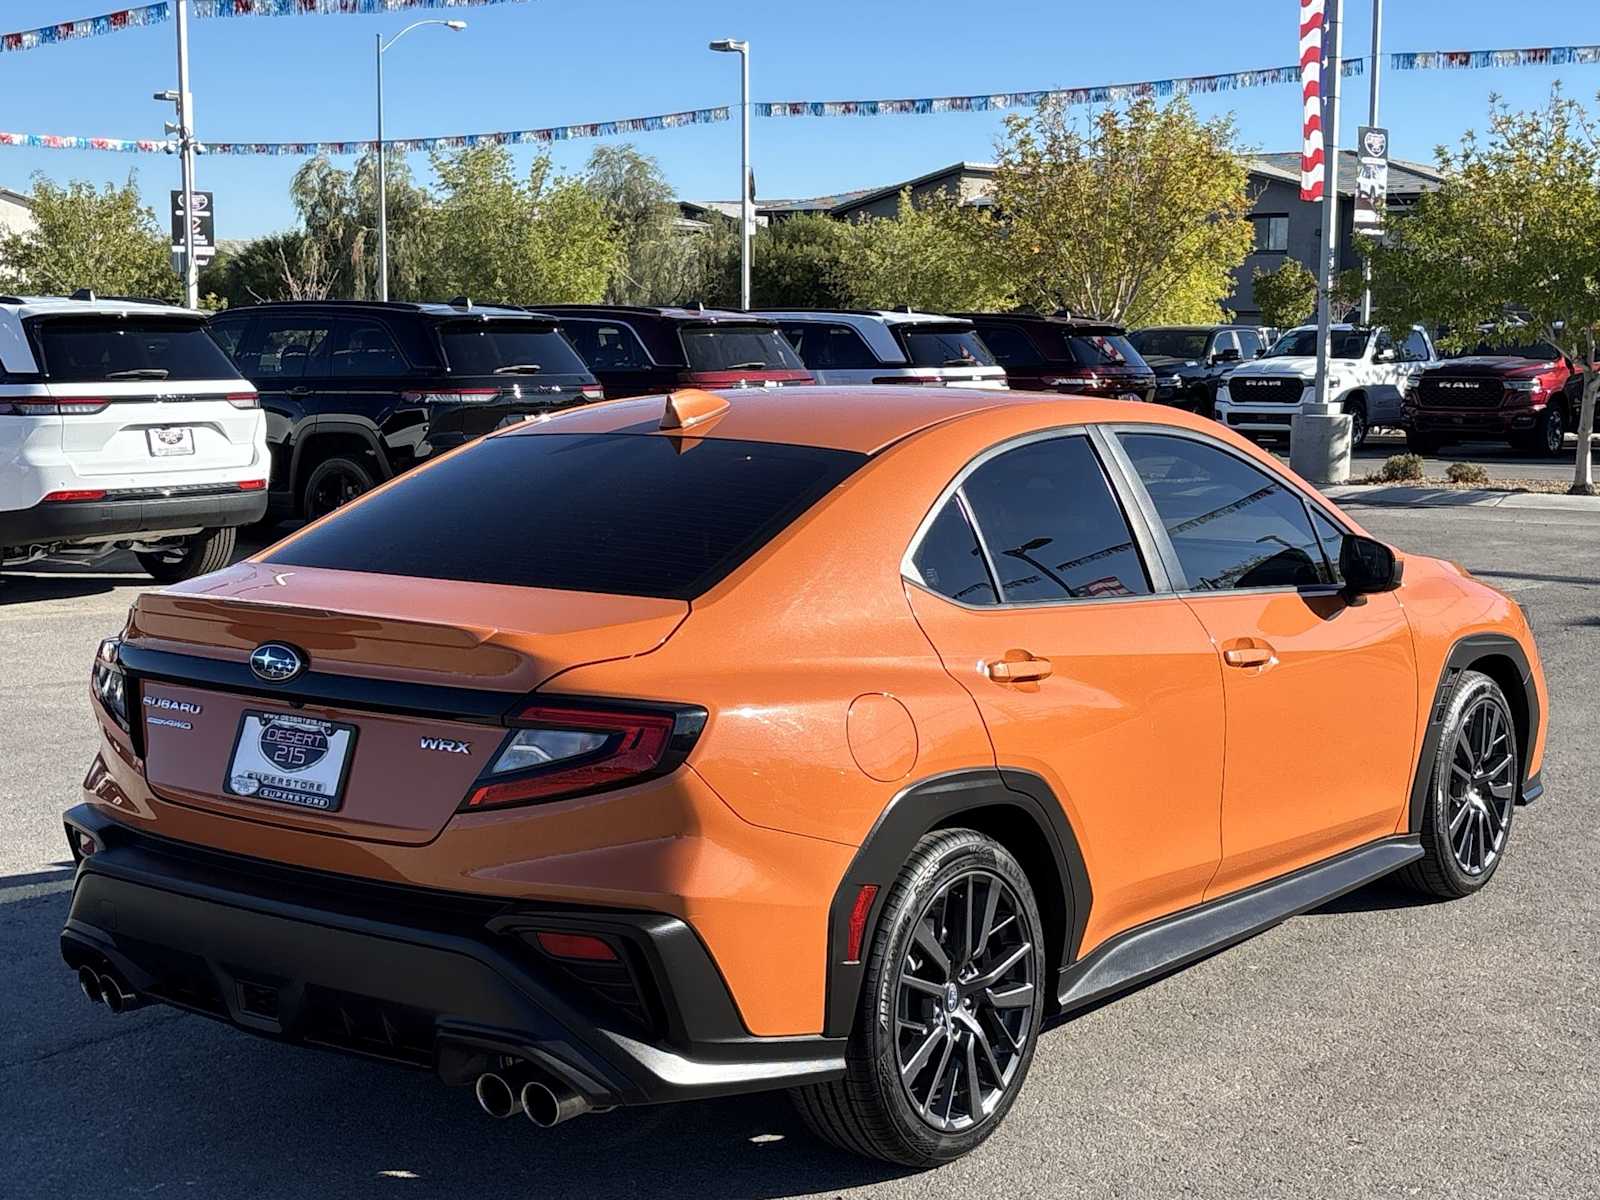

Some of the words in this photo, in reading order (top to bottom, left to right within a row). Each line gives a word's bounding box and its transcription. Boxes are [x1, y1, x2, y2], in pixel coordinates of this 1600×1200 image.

[143, 696, 201, 714] SUBARU
[266, 728, 323, 746] DESERT
[421, 738, 470, 754] WRX
[273, 745, 307, 764] 215
[247, 773, 323, 792] SUPERSTORE
[263, 789, 326, 806] SUPERSTORE
